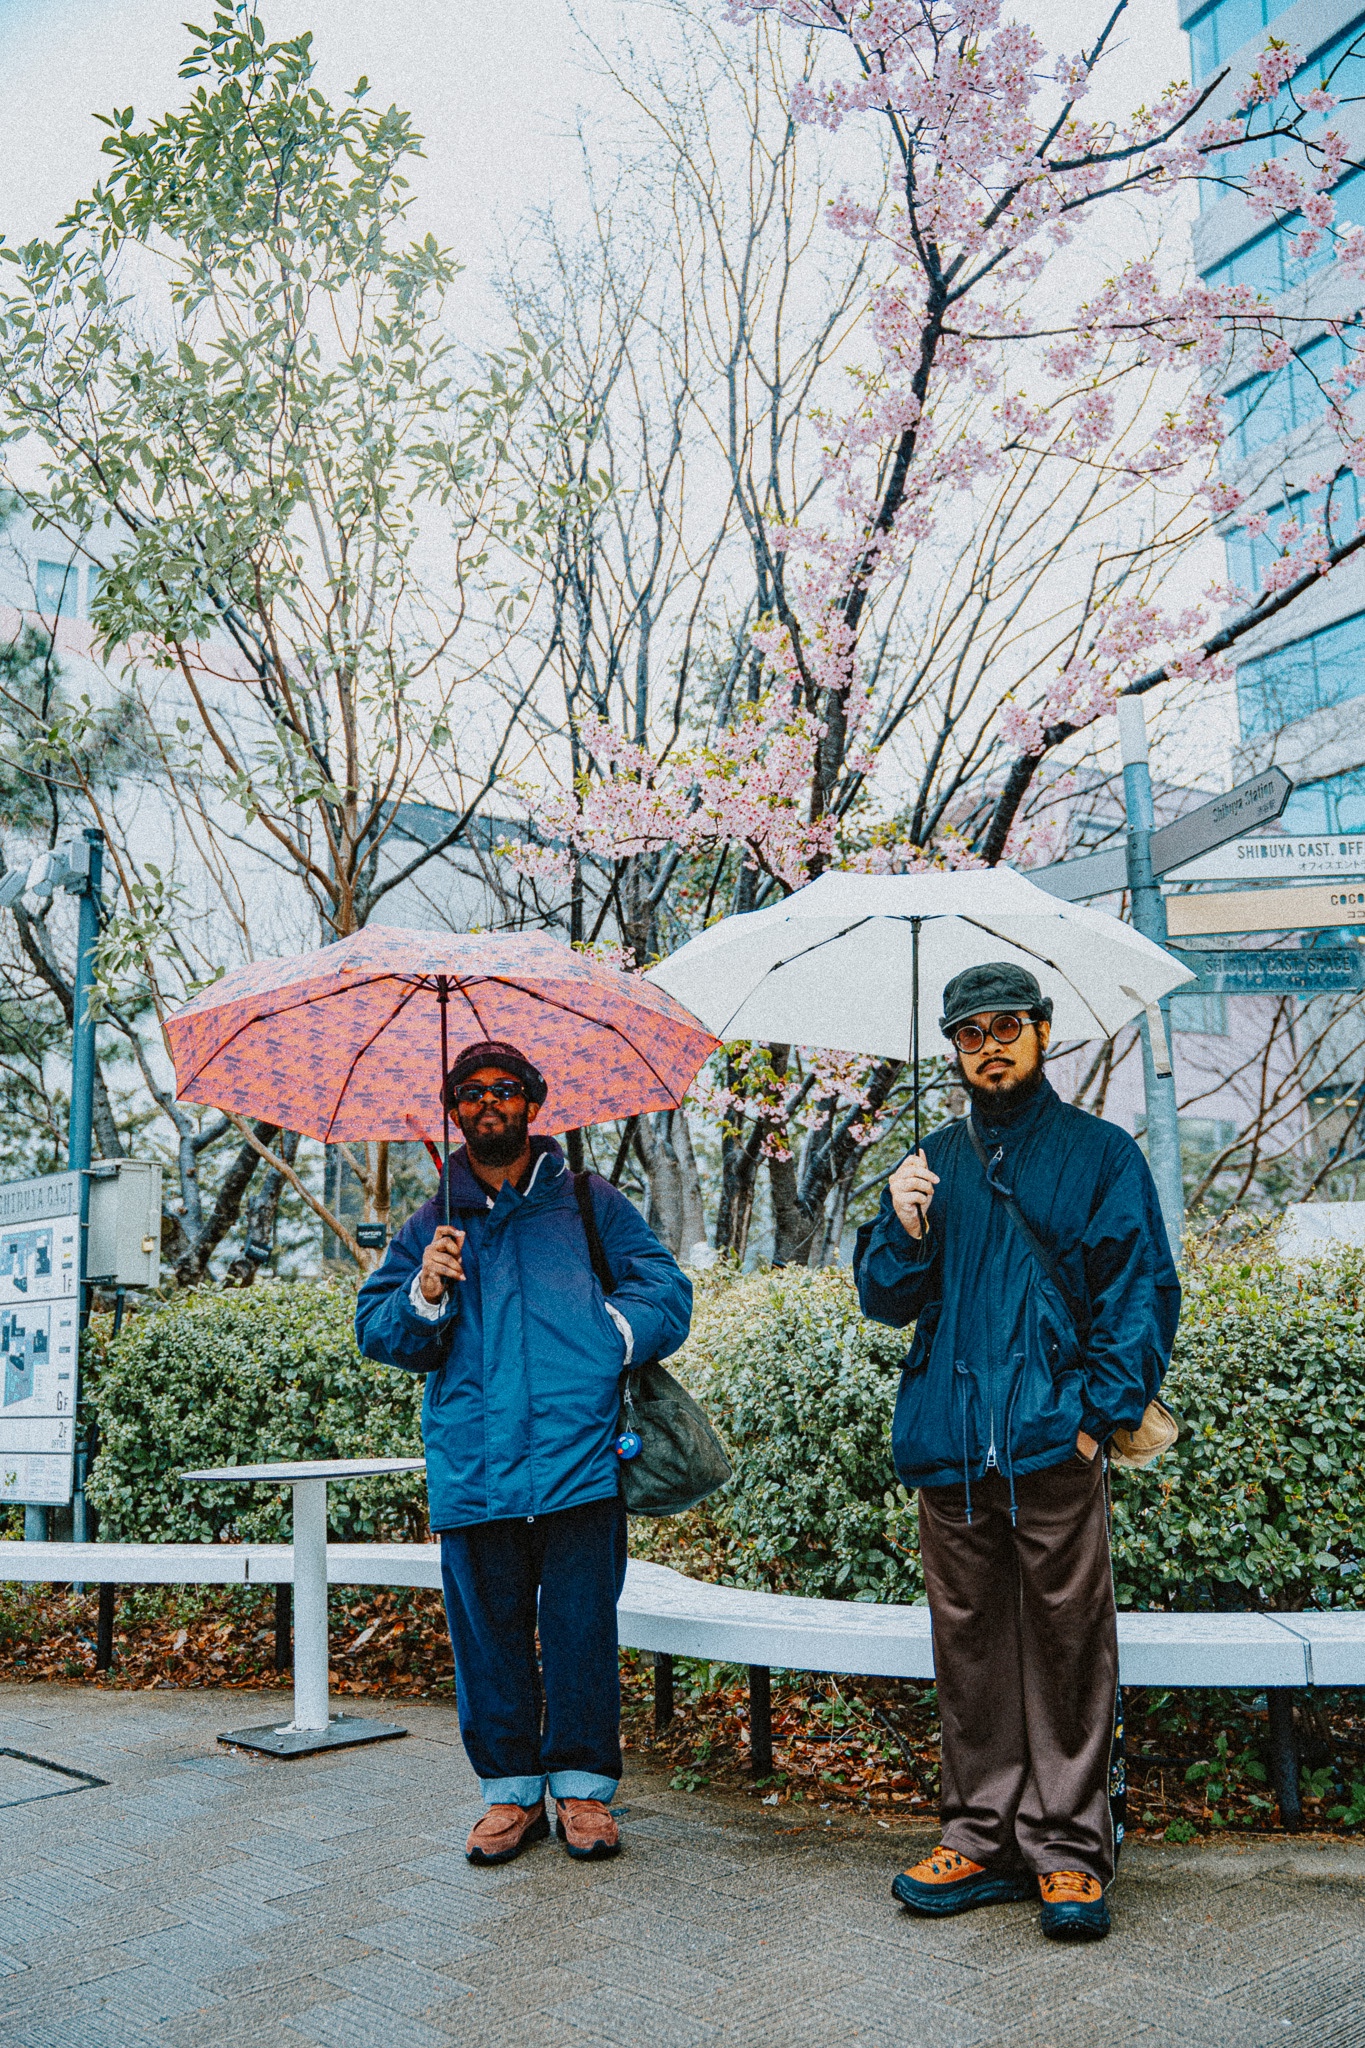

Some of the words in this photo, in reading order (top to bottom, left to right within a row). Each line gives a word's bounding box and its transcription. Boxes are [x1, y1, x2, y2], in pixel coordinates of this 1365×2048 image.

[1244, 781, 1274, 805] Station
[1237, 844, 1294, 859] SHIBUYA
[1298, 842, 1334, 858] CAST.
[1307, 956, 1351, 972] SPACE
[62, 1273, 72, 1293] 1F
